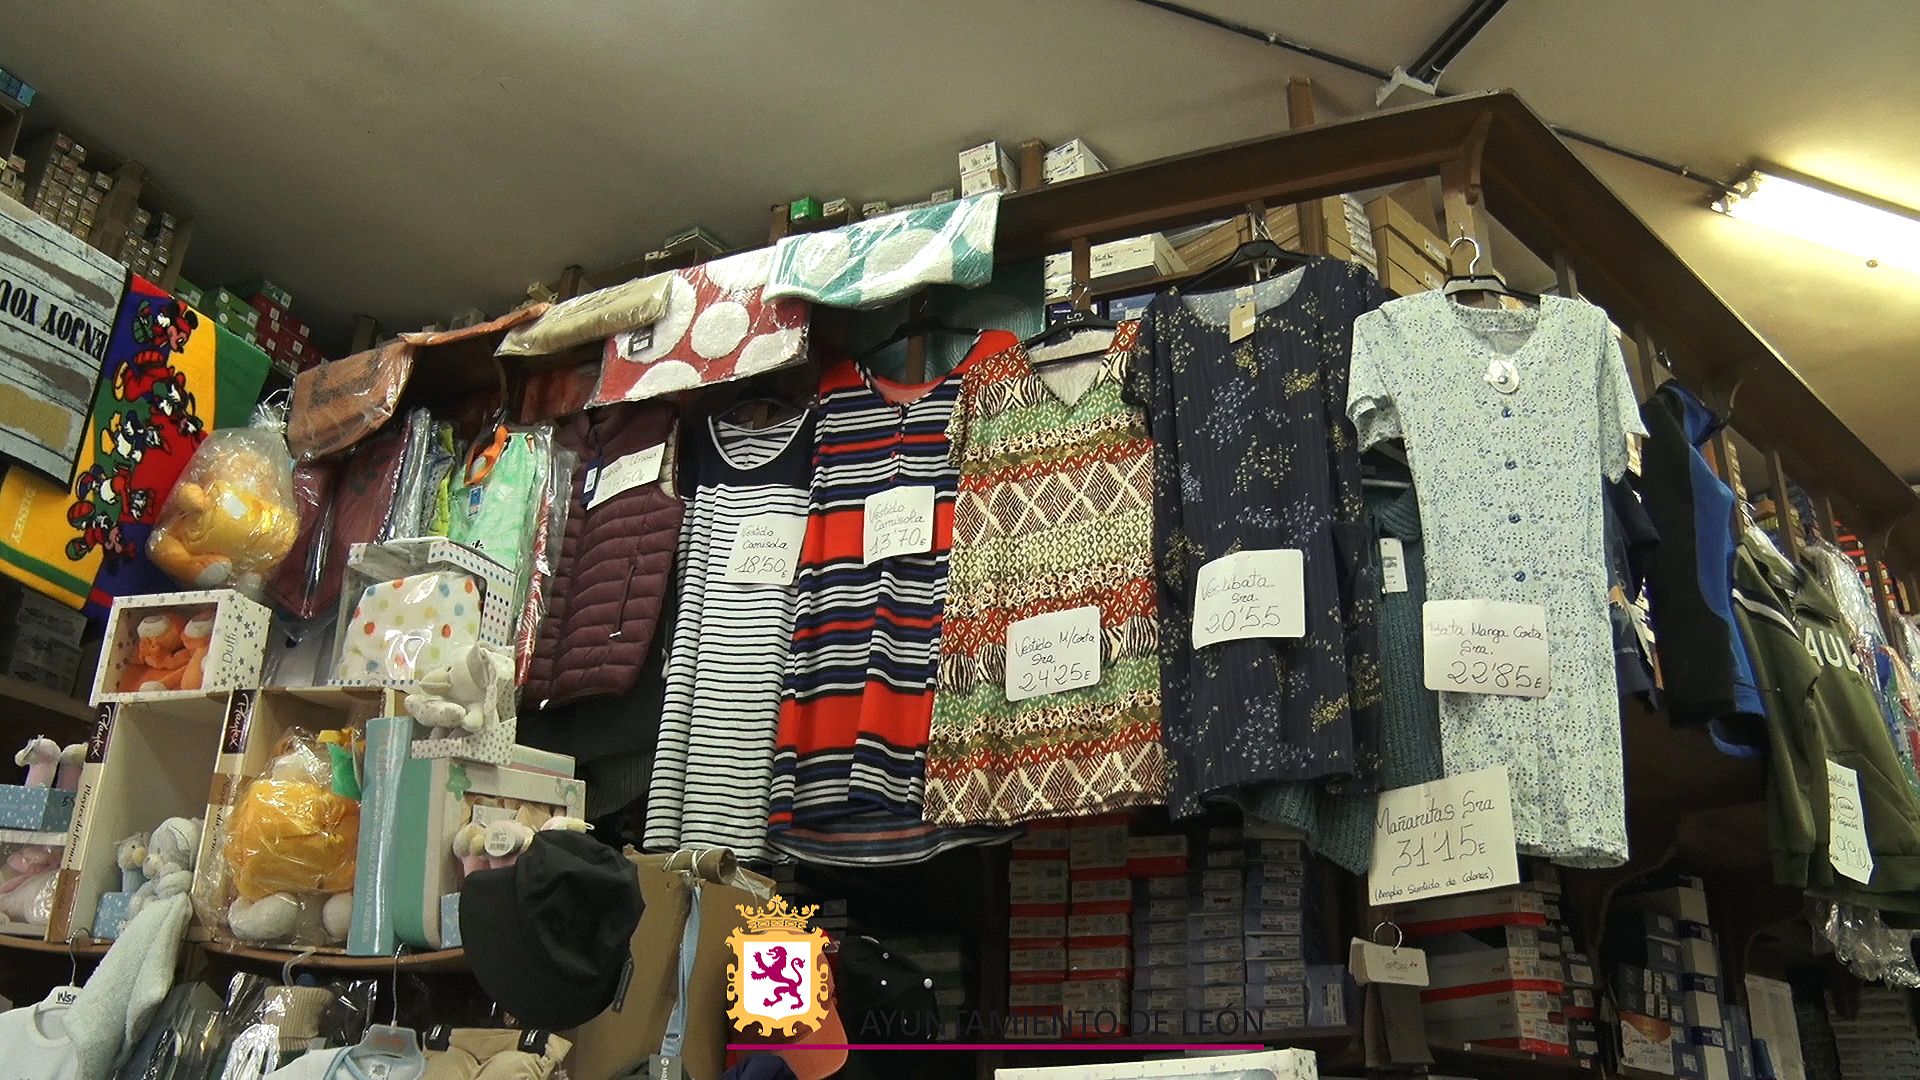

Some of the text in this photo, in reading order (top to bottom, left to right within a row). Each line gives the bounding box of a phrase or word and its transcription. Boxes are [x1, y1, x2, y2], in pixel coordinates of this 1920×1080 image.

[41, 303, 108, 363] ENJOY
[874, 510, 925, 532] Camisola
[743, 538, 788, 550] Camisola
[1205, 605, 1281, 635] 20'55
[1425, 618, 1465, 636] Bata
[1472, 622, 1509, 644] Manga
[1015, 636, 1053, 658] Vestido
[91, 705, 112, 758] Playtex
[229, 692, 249, 748] Playtex
[77, 784, 93, 820] Playtex
[1461, 790, 1495, 819] Sra
